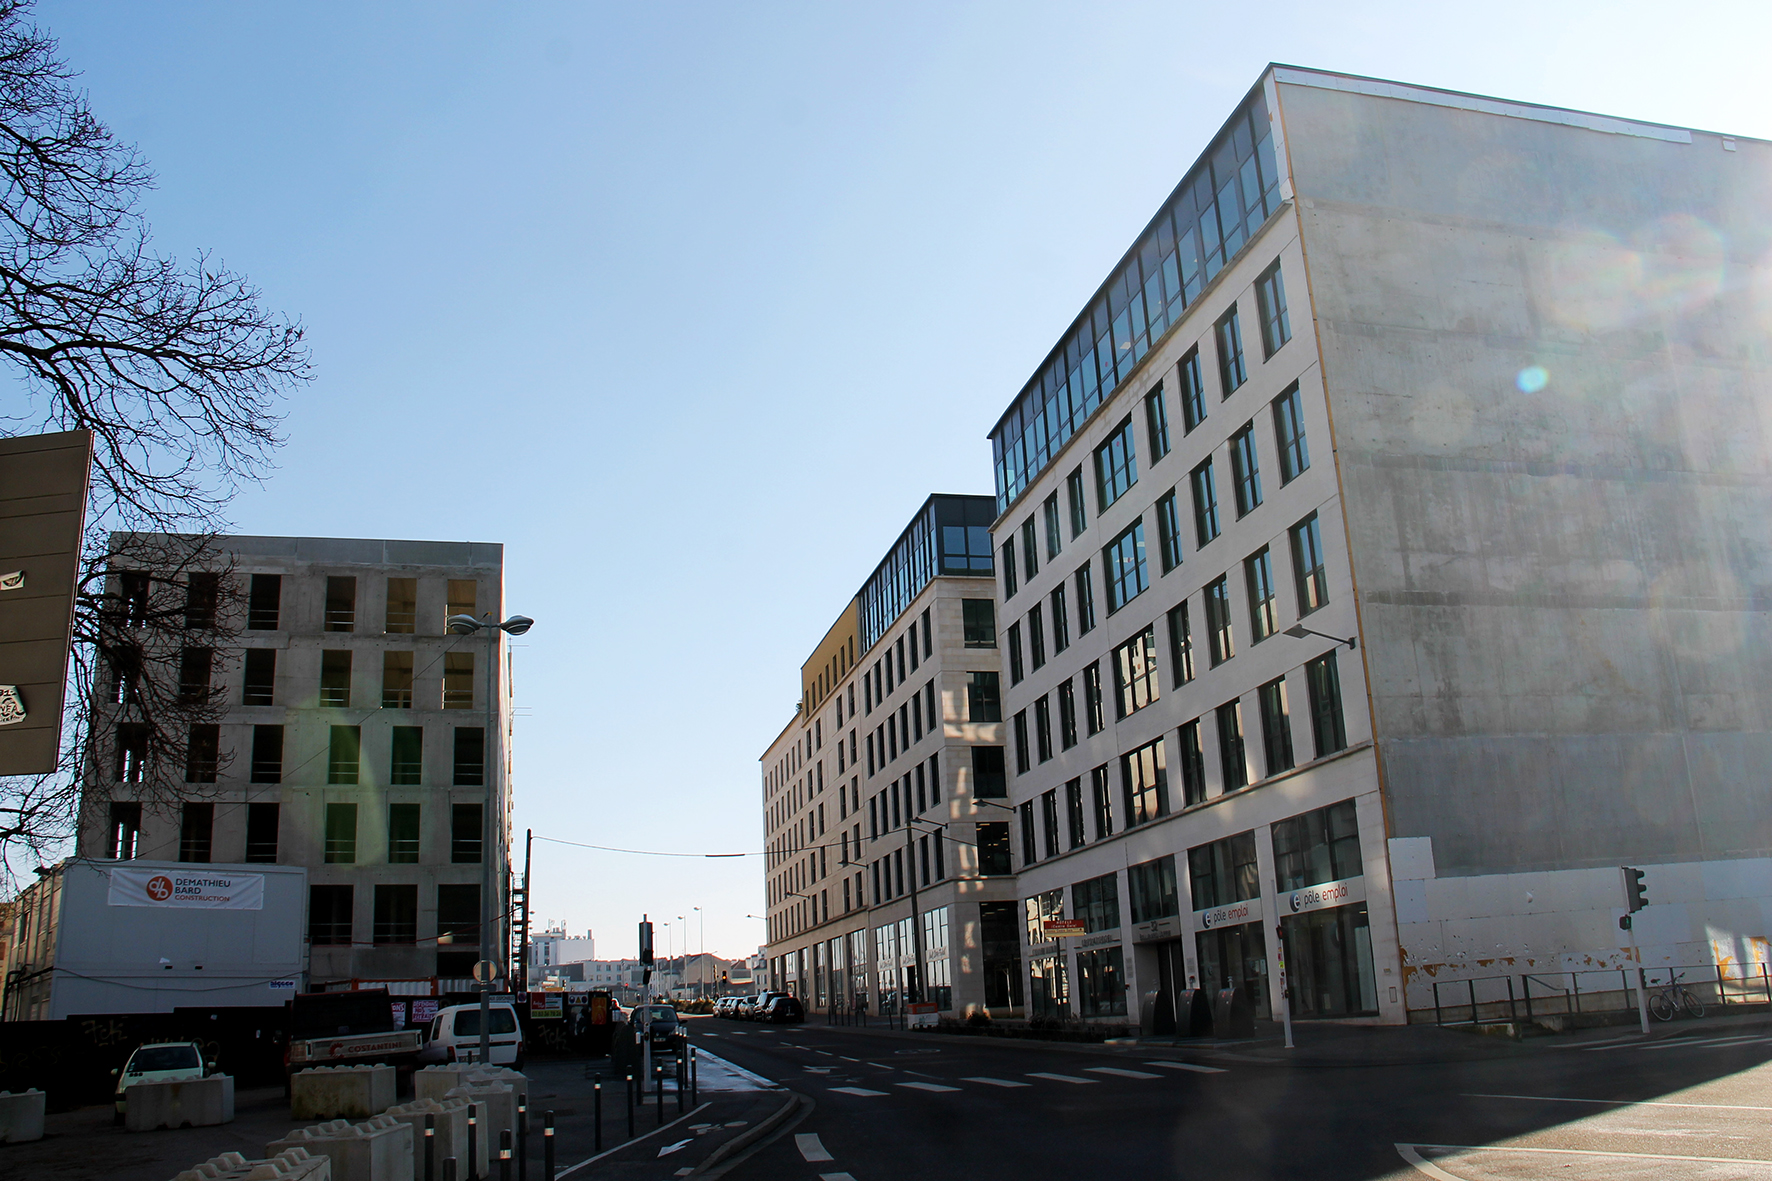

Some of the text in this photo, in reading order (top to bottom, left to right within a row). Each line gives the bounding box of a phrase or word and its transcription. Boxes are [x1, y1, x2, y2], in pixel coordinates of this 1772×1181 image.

[175, 878, 231, 888] DEMATHIEU
[174, 886, 202, 895] BARD
[1304, 890, 1320, 908] pôle
[1322, 882, 1349, 902] emploi
[174, 894, 231, 902] CONSTRUCTION
[1213, 908, 1226, 926] pôle
[1228, 903, 1249, 921] emploi
[347, 1041, 402, 1053] COSTANTINI
